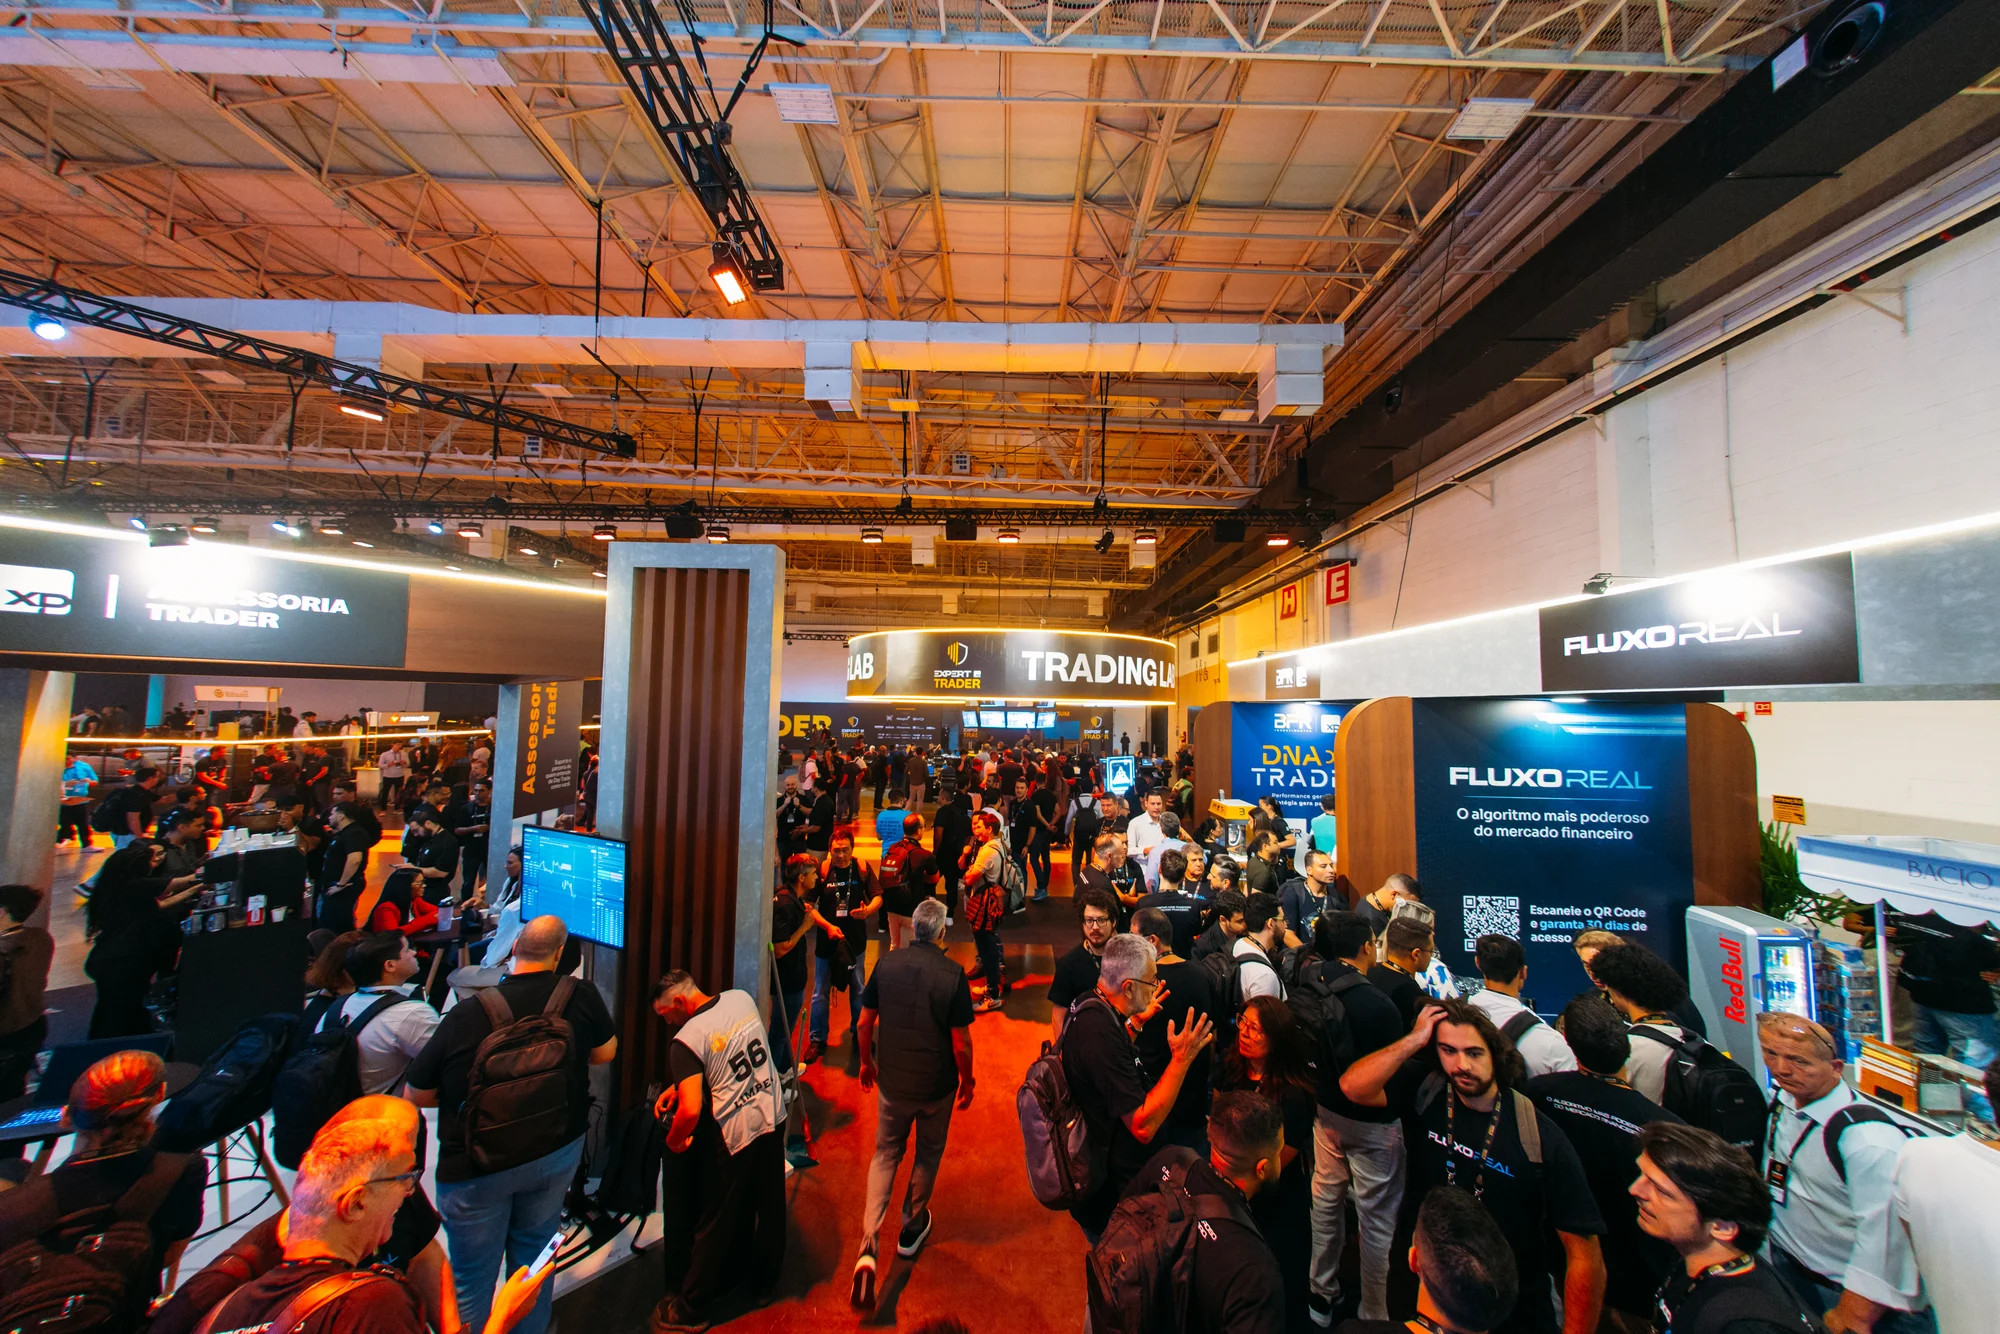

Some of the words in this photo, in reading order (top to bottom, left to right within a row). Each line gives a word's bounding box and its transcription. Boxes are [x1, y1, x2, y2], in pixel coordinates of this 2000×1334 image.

[1331, 569, 1347, 600] E
[147, 584, 349, 615] SSORIA
[1283, 589, 1296, 615] H
[146, 602, 280, 629] TRADER
[934, 670, 972, 678] EXPERT
[1021, 650, 1157, 687] TRADING
[934, 678, 981, 689] TRADER
[1274, 713, 1312, 729] BFR
[1262, 745, 1322, 766] DNA
[1271, 792, 1311, 800] Performance
[1456, 808, 1469, 820] O
[1471, 809, 1541, 823] algoritmo
[1544, 811, 1578, 822] mais
[1580, 811, 1650, 825] poderoso
[1474, 825, 1493, 837] do
[1496, 826, 1559, 838] mercado
[1561, 827, 1634, 840] financeiro
[1908, 860, 1994, 890] BACIO
[1529, 905, 1582, 916] Escaneie
[1583, 908, 1592, 916] o
[1593, 907, 1612, 919] QR
[1614, 907, 1647, 918] Code
[1530, 920, 1538, 928] e
[1540, 920, 1585, 931] garanta
[1604, 920, 1630, 931] dias
[1631, 921, 1648, 931] de
[1530, 934, 1572, 943] acesso
[727, 1037, 768, 1083] 56
[733, 1077, 774, 1109] LIMPE
[1611, 1115, 1647, 1134] PODERO
